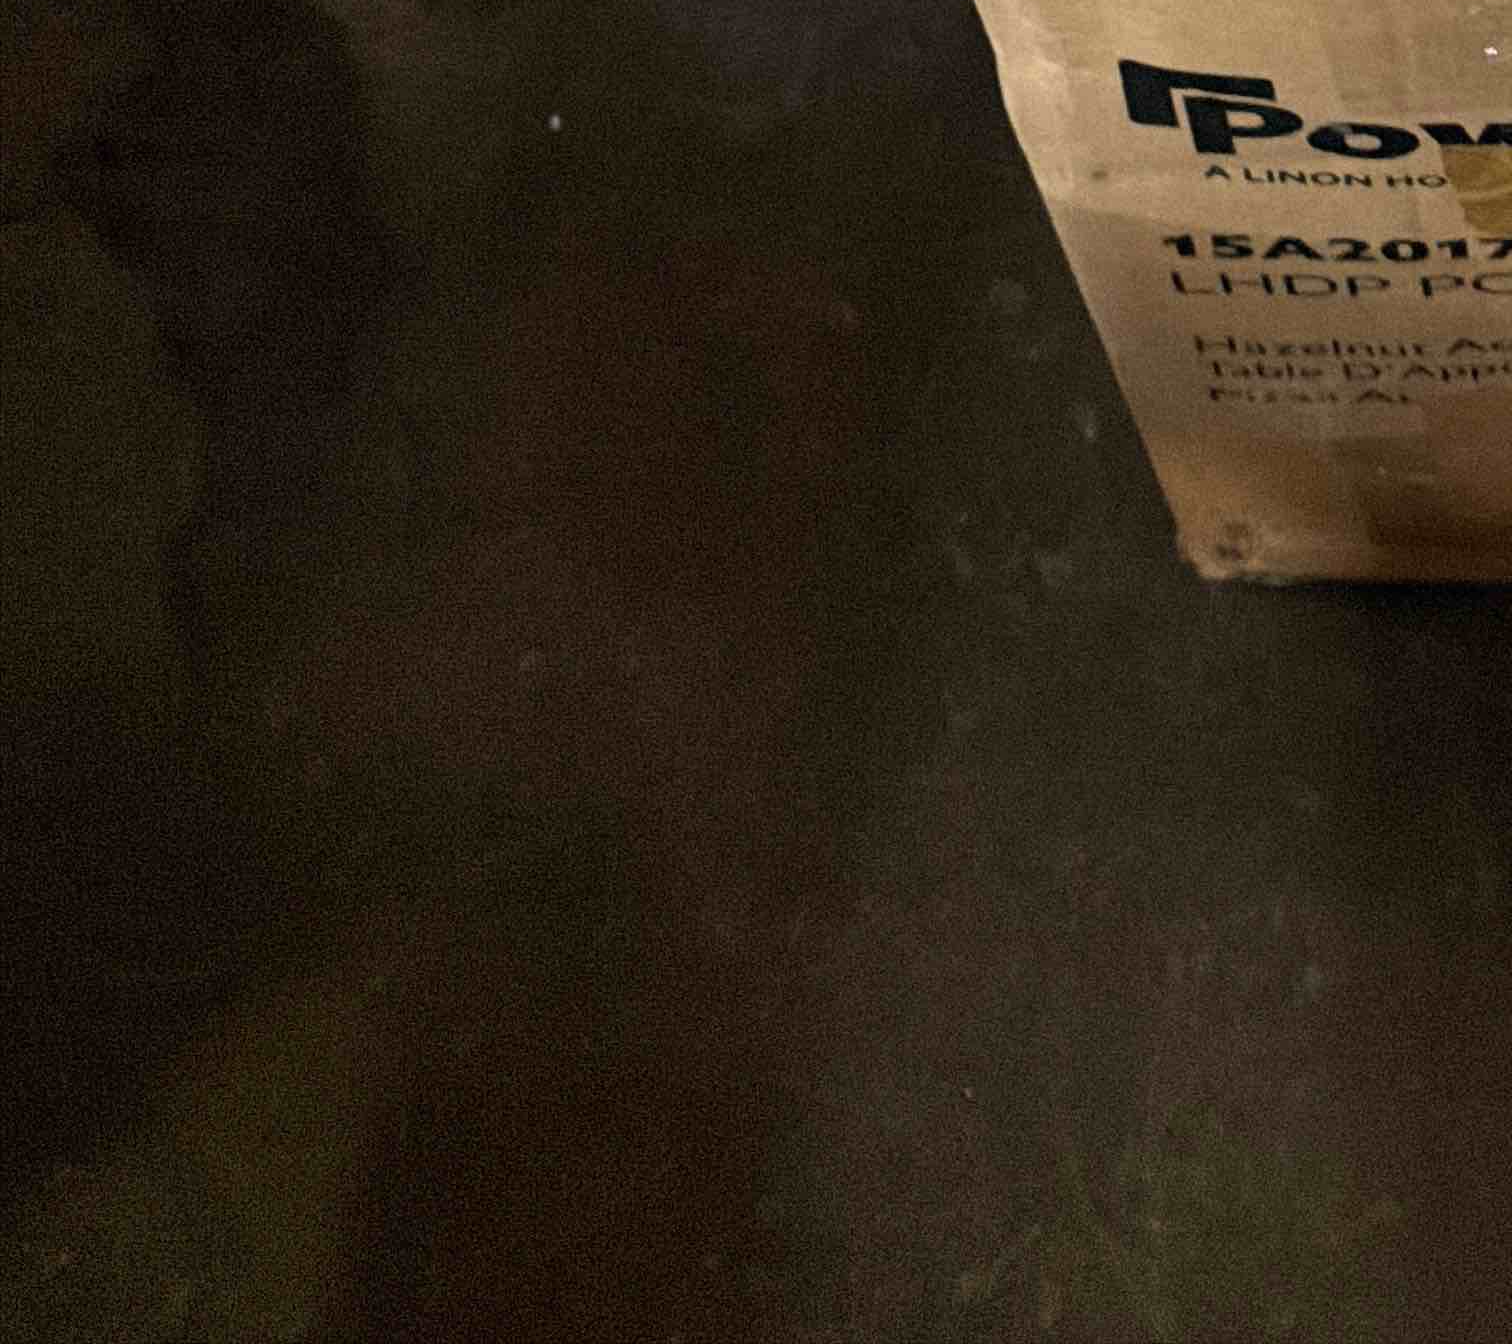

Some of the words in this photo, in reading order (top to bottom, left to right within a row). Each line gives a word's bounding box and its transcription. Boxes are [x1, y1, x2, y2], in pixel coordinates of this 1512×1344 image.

[1204, 164, 1229, 180] A
[1243, 168, 1373, 189] LINON
[1386, 174, 1451, 189] HO
[1170, 271, 1391, 299] LHDP
[1194, 335, 1424, 357] Hazelnut
[1210, 360, 1323, 380] Table
